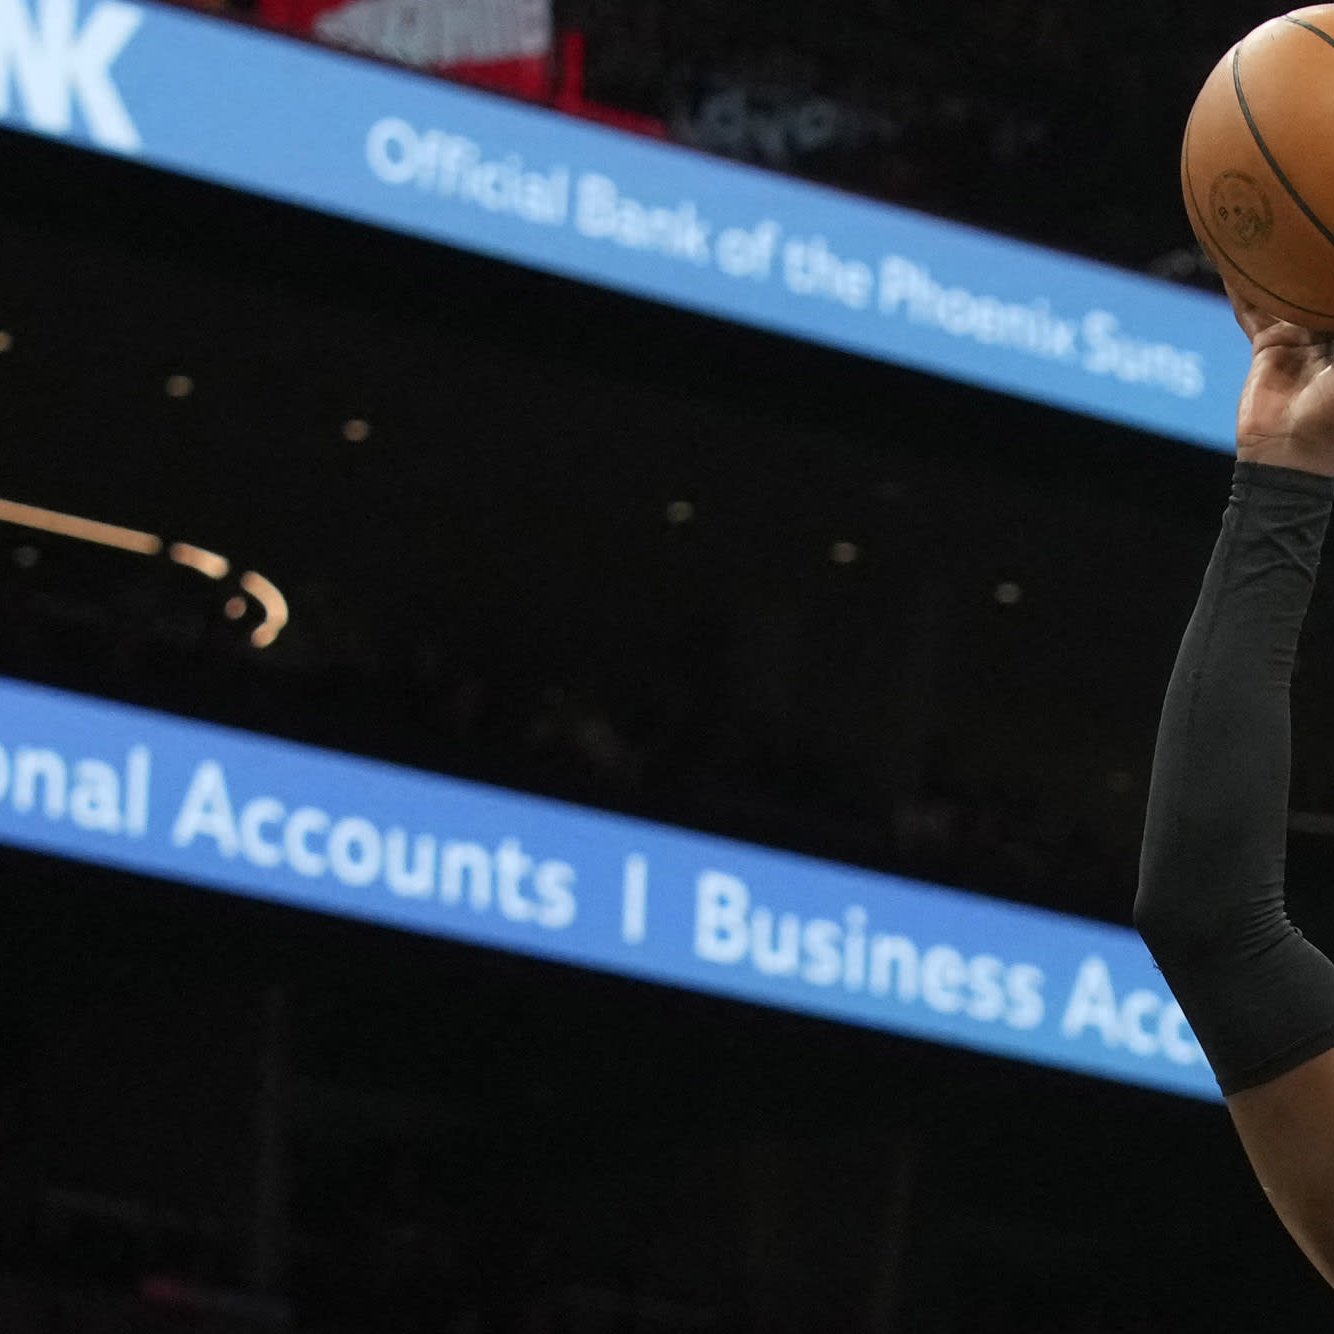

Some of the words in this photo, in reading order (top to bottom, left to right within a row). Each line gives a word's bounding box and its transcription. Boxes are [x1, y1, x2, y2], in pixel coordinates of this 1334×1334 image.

[367, 117, 569, 223] Official
[576, 174, 712, 267] Bank
[716, 220, 782, 278] of
[783, 234, 874, 309] the
[877, 253, 1083, 358] Phoenix
[1083, 311, 1205, 398] Suns
[172, 760, 576, 929] Accounts
[695, 870, 1046, 1030] Business
